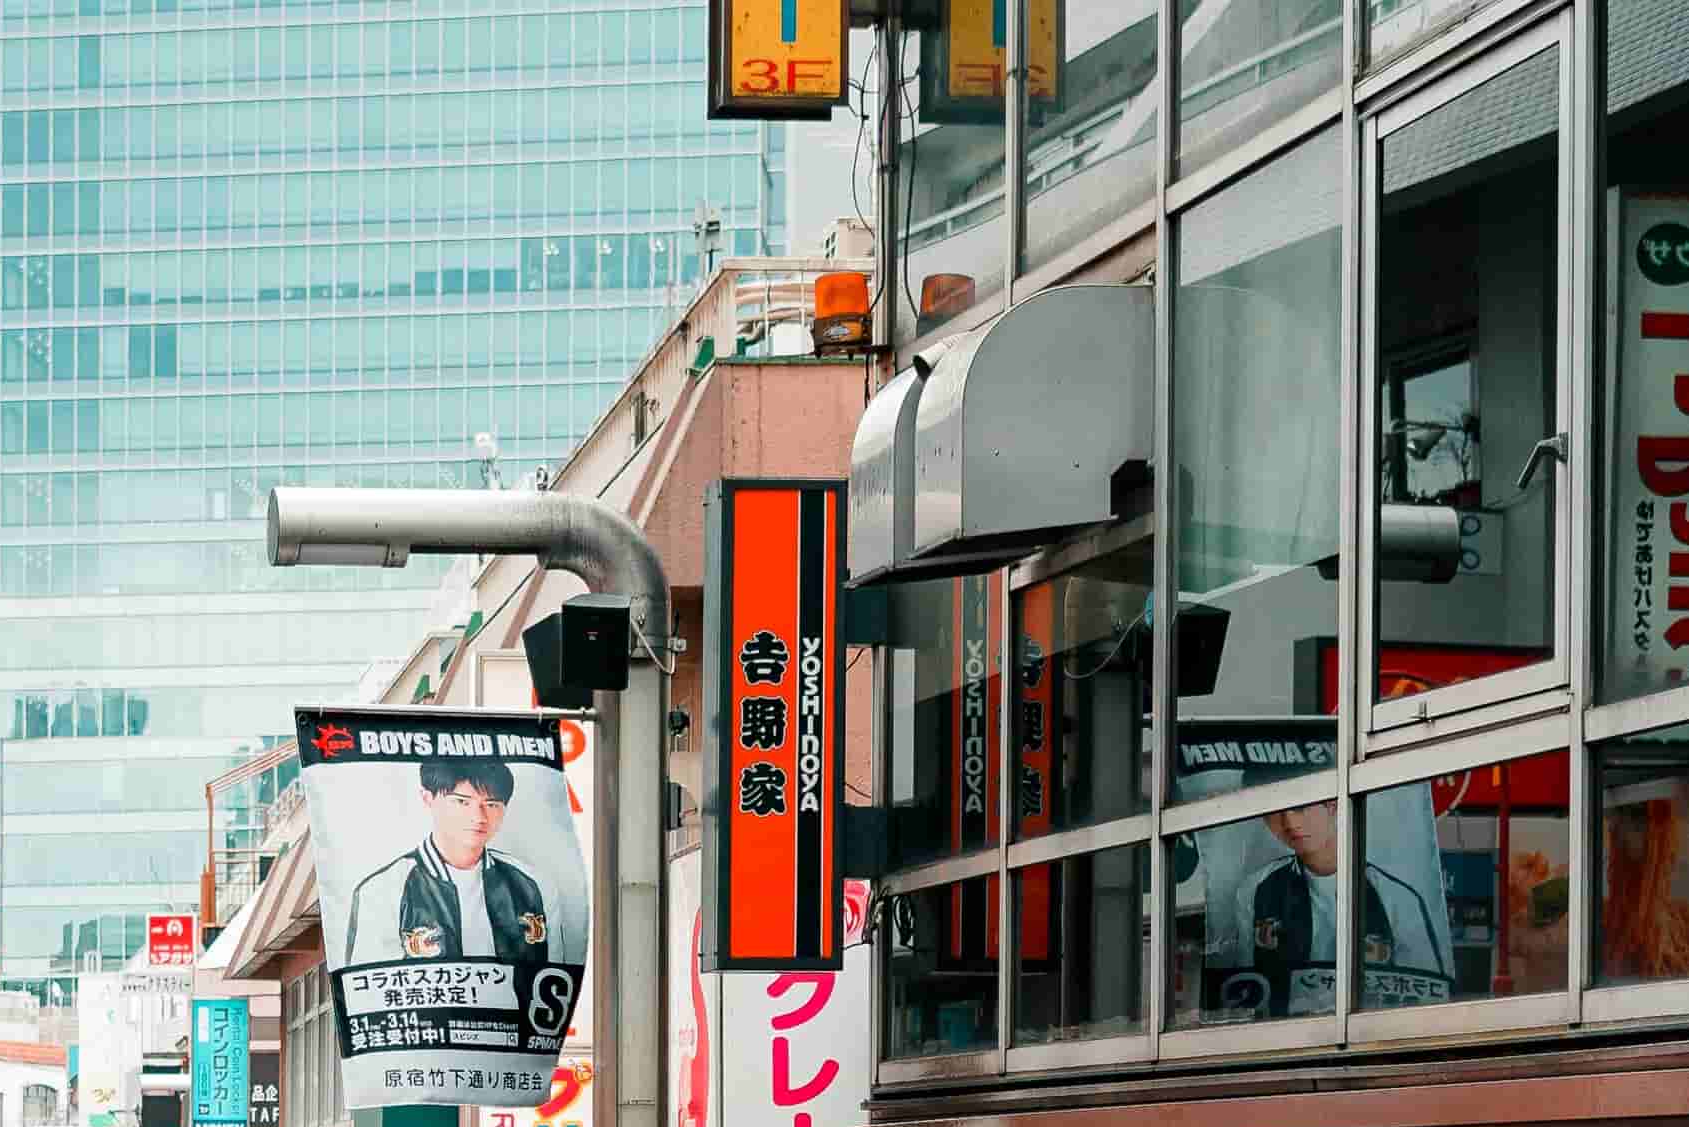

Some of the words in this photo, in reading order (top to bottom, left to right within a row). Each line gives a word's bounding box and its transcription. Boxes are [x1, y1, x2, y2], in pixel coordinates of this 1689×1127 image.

[740, 58, 834, 94] 3F
[739, 630, 790, 818] 吉野家
[800, 636, 824, 814] YOSHINOYA
[359, 730, 431, 757] BOYS
[437, 731, 500, 757] AND
[504, 734, 555, 759] MEN
[352, 967, 507, 992] コラボスカジャン
[383, 986, 478, 1007] 発売決定!
[351, 1027, 446, 1050] 受注受付中!
[214, 1008, 229, 1115] コインロッカー
[383, 1067, 544, 1091] 原宿竹下通り商店会
